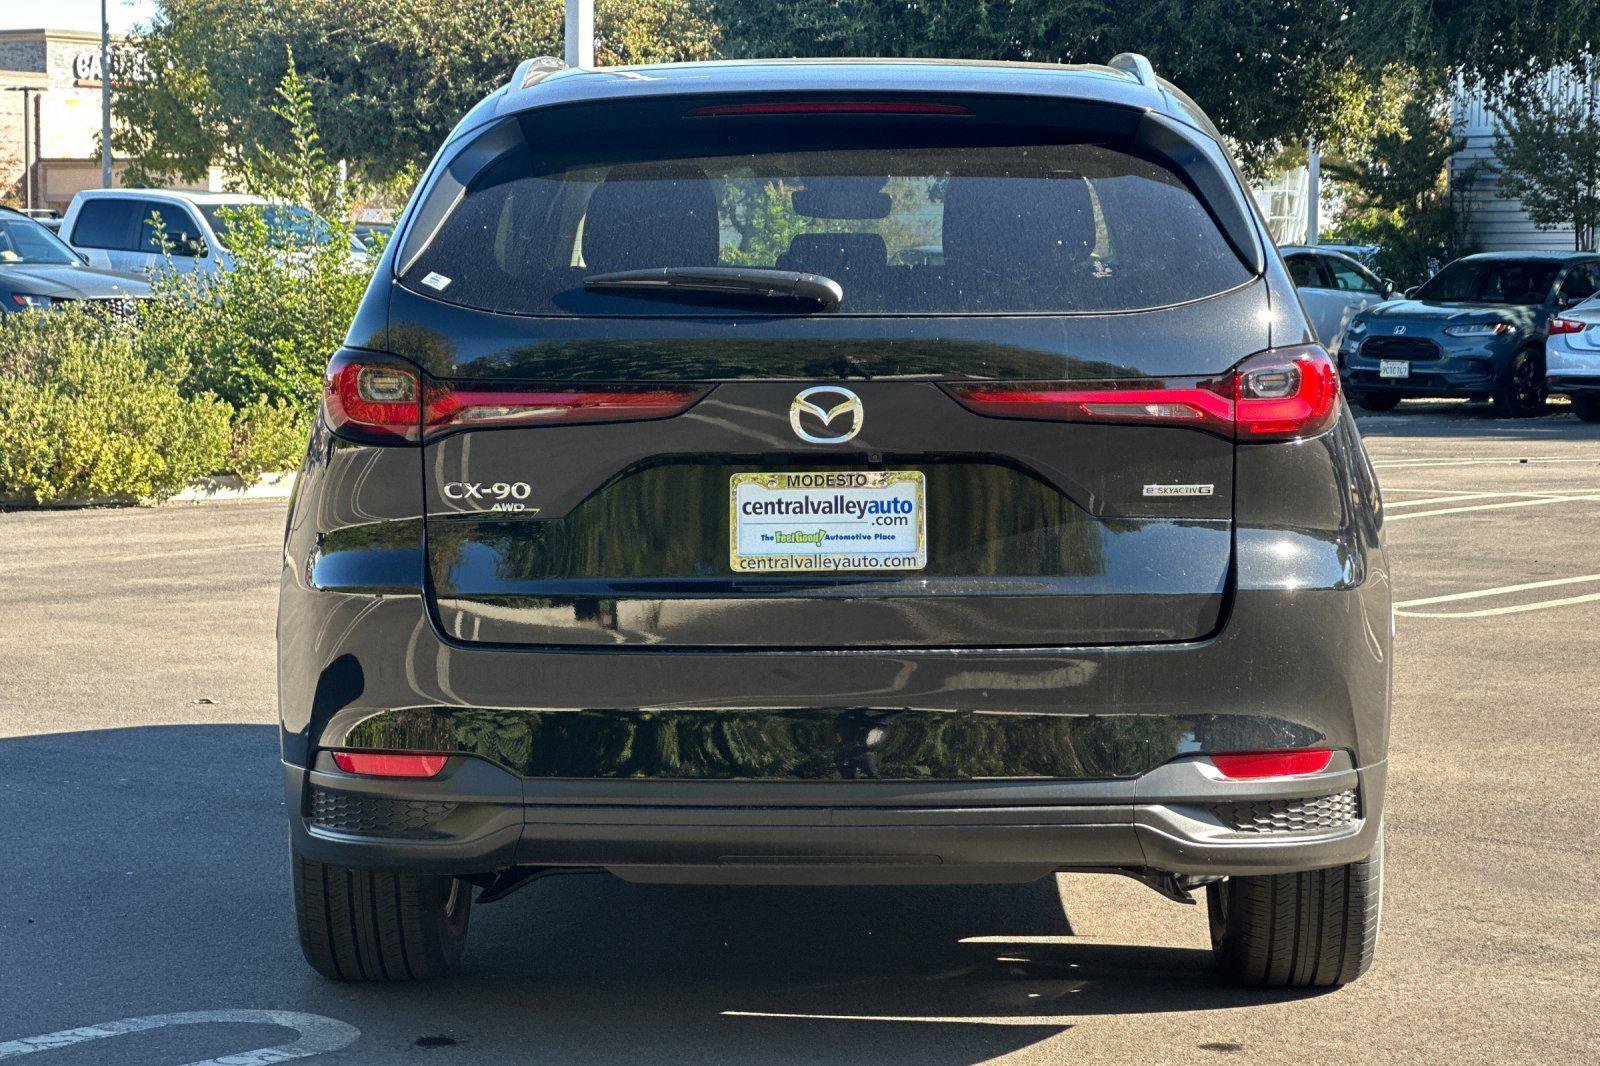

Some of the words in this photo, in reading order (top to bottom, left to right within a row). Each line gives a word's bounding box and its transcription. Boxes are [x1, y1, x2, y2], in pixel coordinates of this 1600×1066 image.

[787, 475, 868, 487] MODESTO
[443, 482, 532, 499] CX-90
[491, 502, 525, 511] AWD
[871, 515, 909, 526] .com
[761, 533, 774, 541] The
[825, 532, 872, 541] Automotive
[874, 532, 896, 541] Place
[739, 555, 917, 570] centralvalleyauto.com
